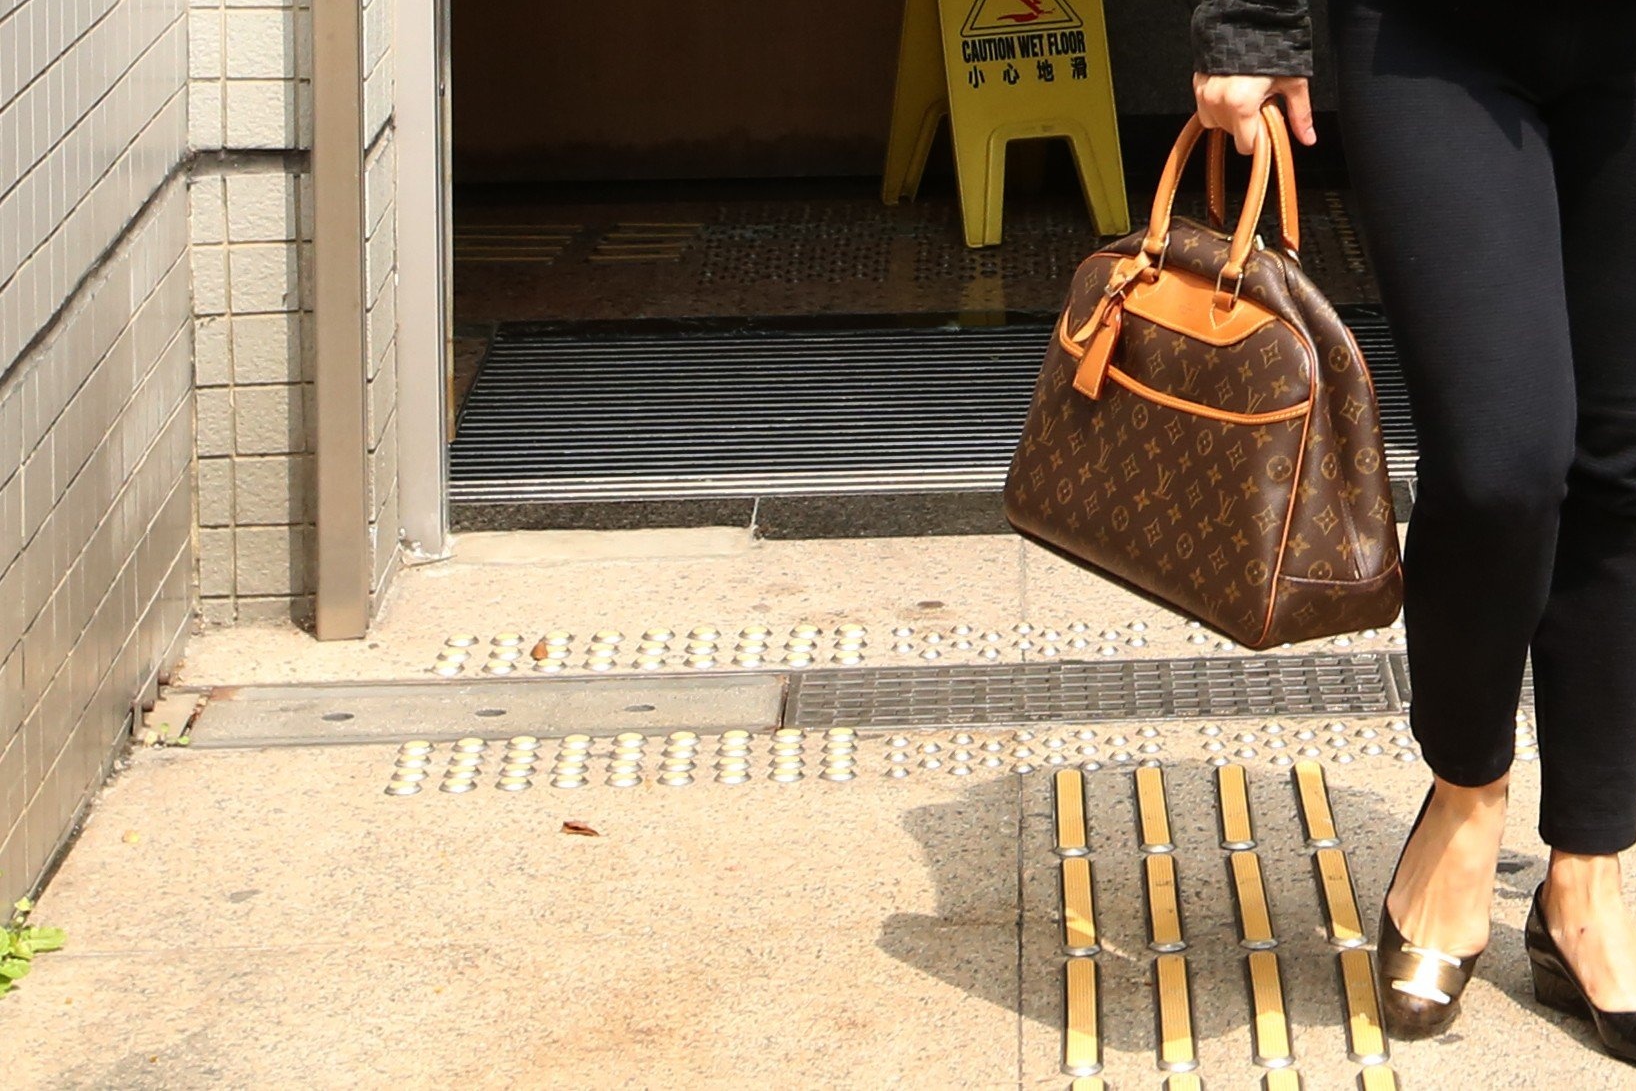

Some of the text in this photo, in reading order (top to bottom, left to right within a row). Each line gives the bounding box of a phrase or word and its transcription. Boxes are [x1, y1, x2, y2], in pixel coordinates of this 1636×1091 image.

[962, 30, 1086, 64] CAUTION WET FLOOR
[968, 56, 1088, 89] 小心地滑
